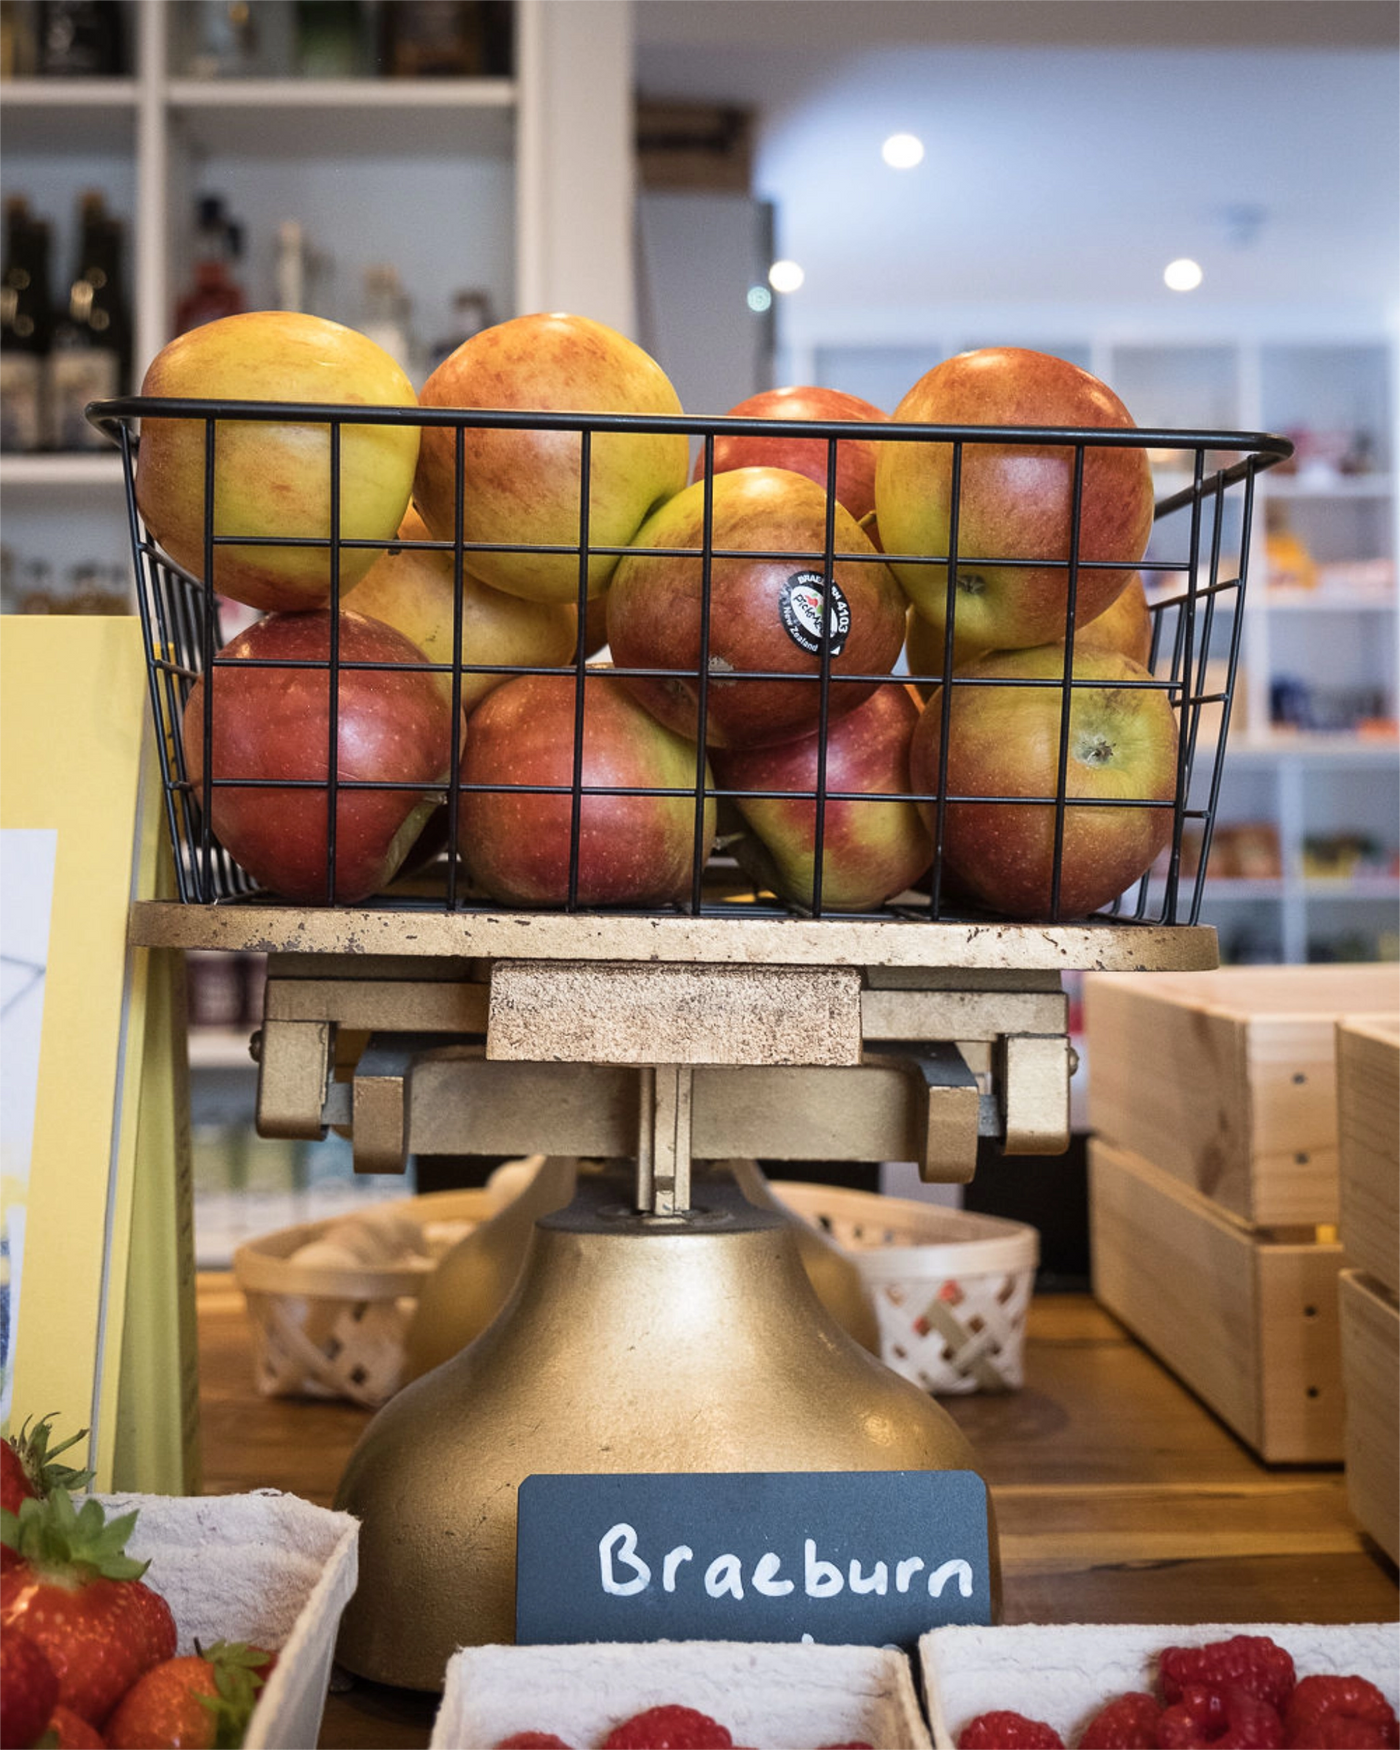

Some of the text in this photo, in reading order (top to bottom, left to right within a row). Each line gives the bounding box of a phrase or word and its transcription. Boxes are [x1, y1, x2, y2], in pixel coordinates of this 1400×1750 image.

[783, 606, 793, 626] New
[790, 625, 819, 652] Zealand
[837, 601, 849, 634] 4103
[598, 1522, 973, 1601] Braeburn
